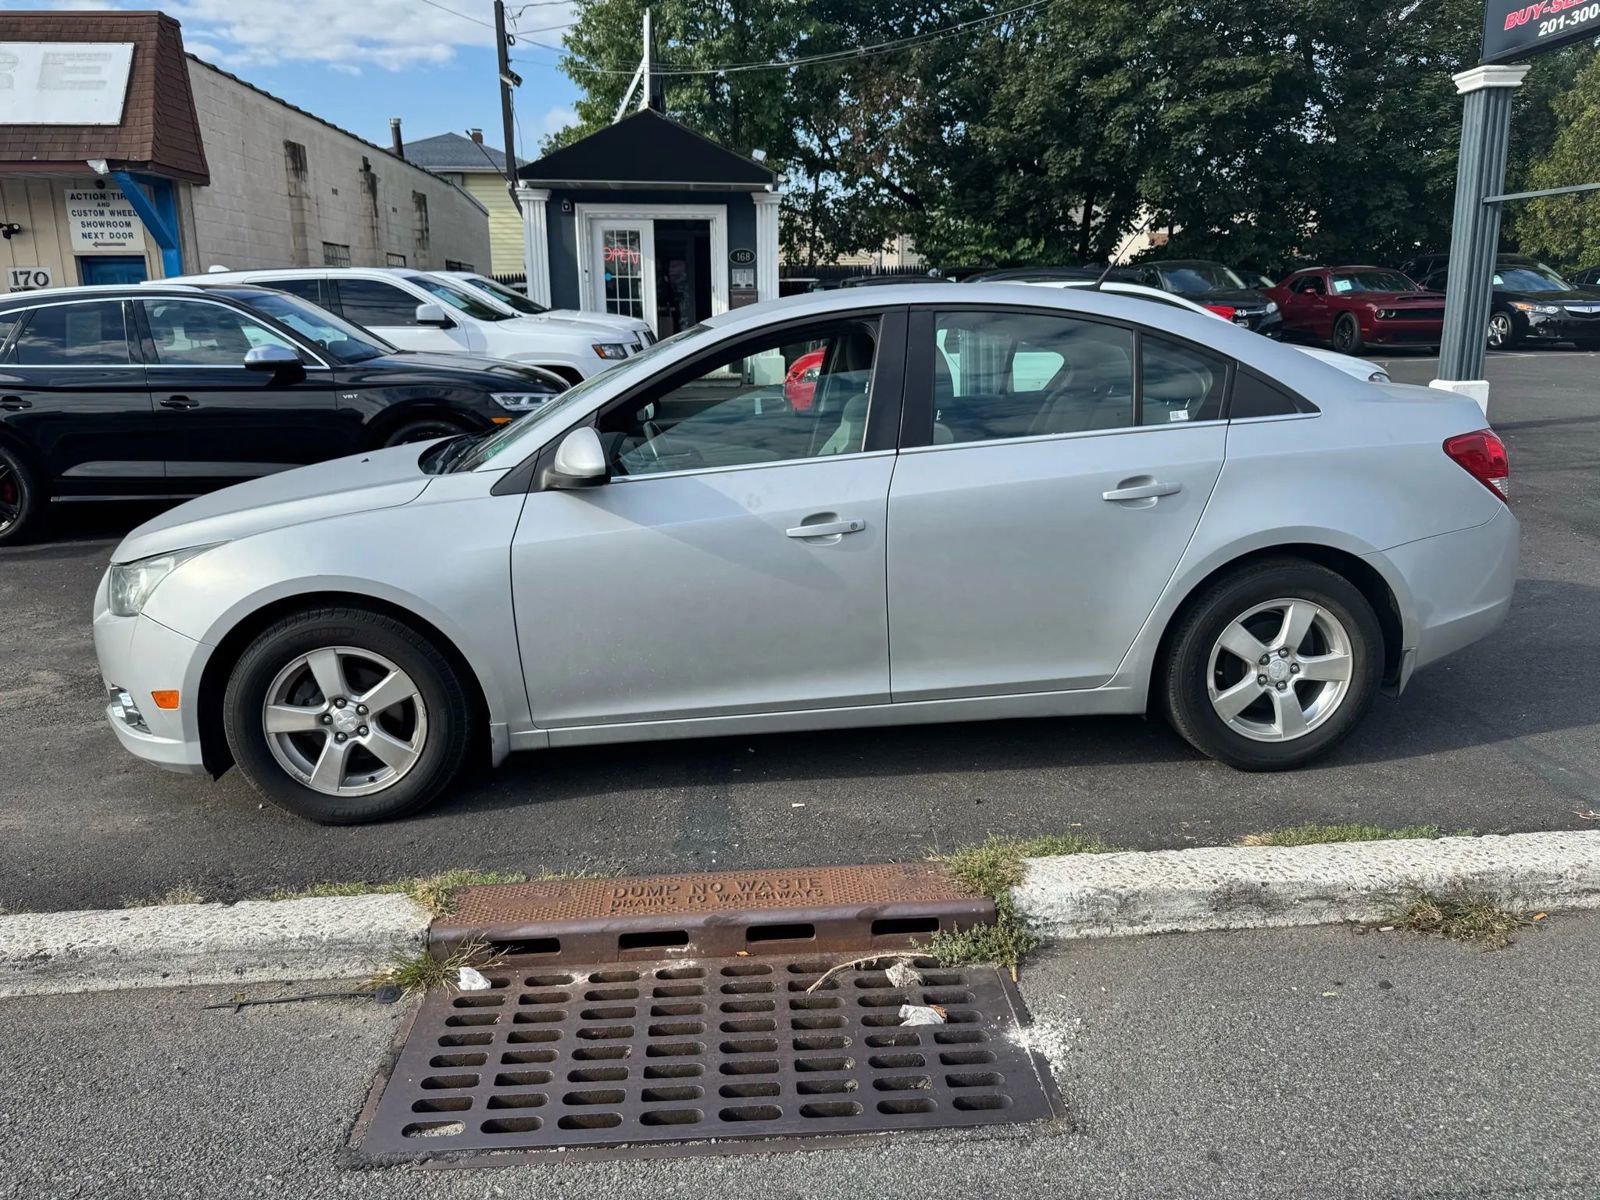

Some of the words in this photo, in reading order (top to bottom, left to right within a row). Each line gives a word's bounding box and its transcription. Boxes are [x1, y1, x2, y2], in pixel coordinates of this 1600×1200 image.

[70, 192, 107, 200] ACTION
[110, 192, 128, 200] TIR
[71, 209, 105, 217] CUSTOM
[80, 220, 132, 229] SHOWROOM
[81, 231, 105, 240] NEXT
[108, 231, 135, 240] DOOR
[11, 269, 50, 287] 170
[612, 884, 680, 900] DUMP
[690, 881, 724, 896] NO
[735, 877, 824, 893] WASTE
[610, 895, 677, 909] DRAINS
[686, 895, 706, 905] TO
[718, 888, 825, 902] WATERWAYS
